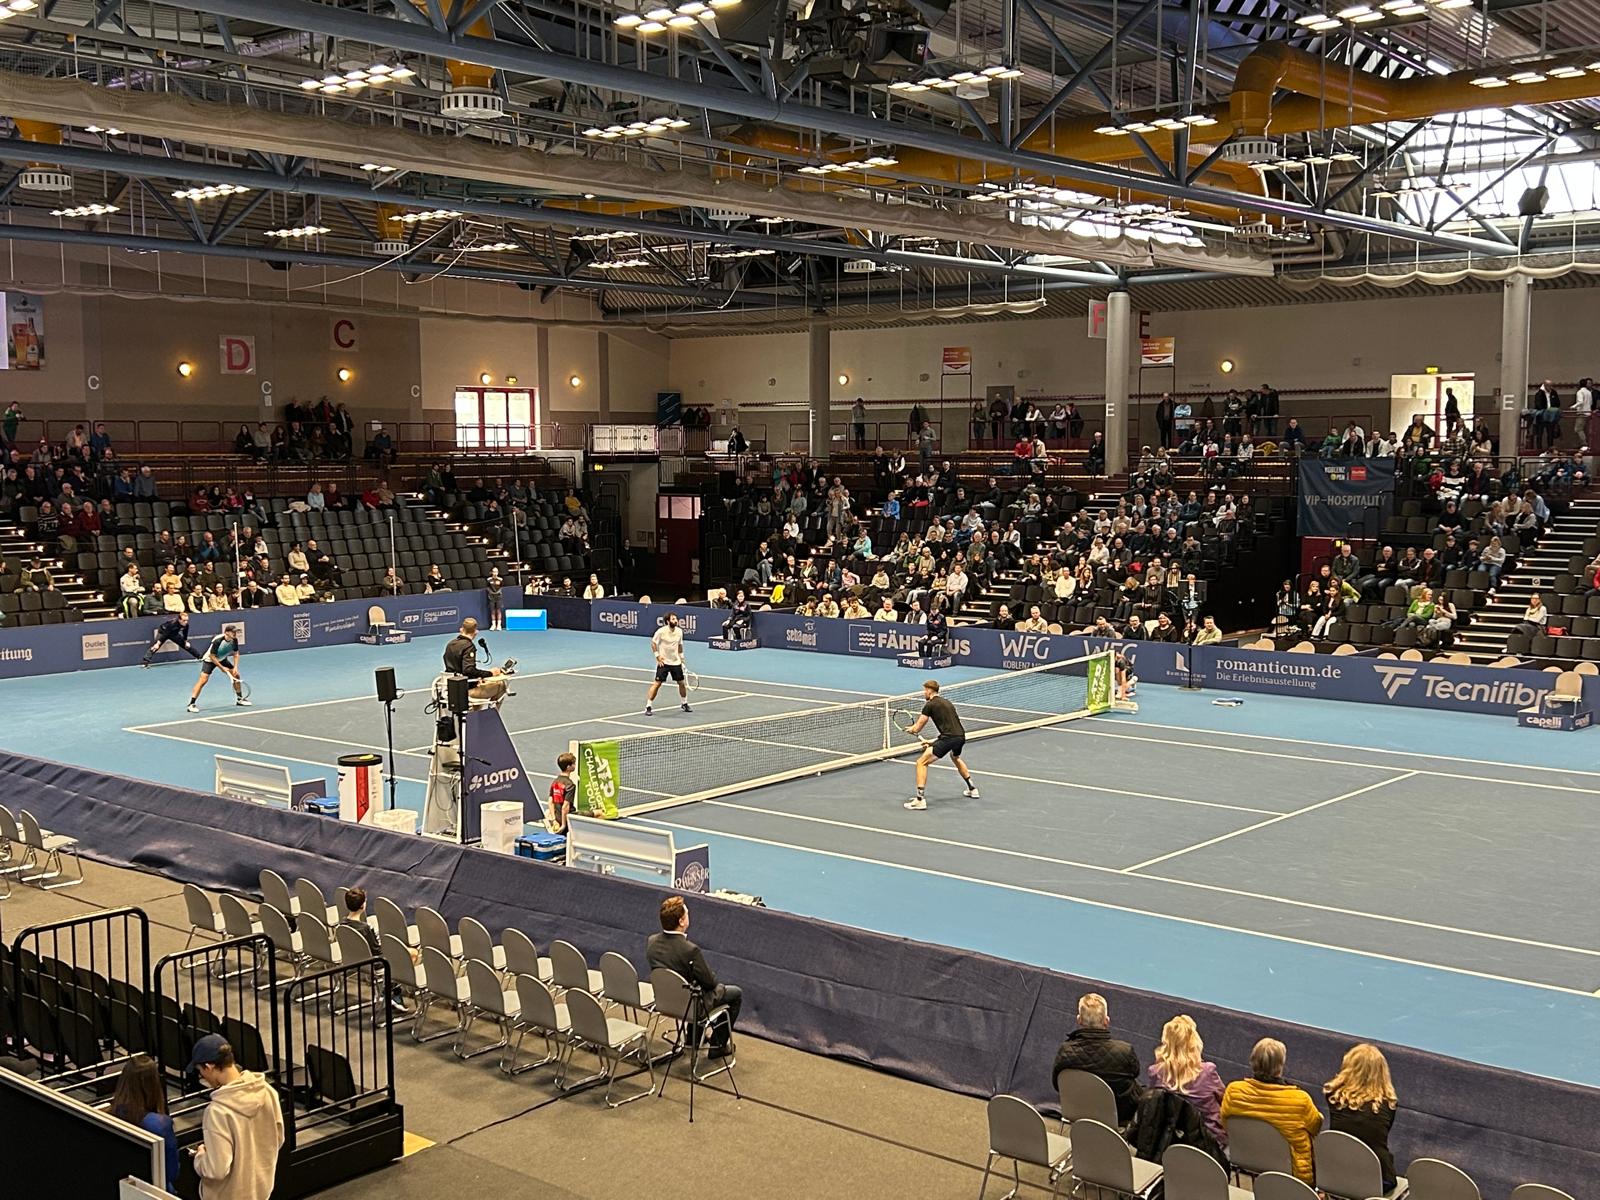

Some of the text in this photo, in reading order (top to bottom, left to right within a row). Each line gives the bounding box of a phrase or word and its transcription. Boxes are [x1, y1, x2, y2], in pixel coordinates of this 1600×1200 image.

[1092, 303, 1105, 336] F
[1139, 310, 1151, 339] E
[333, 319, 356, 349] C
[225, 338, 251, 371] D
[87, 375, 99, 390] C
[261, 381, 272, 395] C
[411, 385, 420, 398] C
[1105, 402, 1115, 416] E
[1503, 394, 1515, 410] E
[424, 609, 458, 618] CHALLENGER
[599, 610, 638, 627] capelli
[656, 614, 697, 630] celli
[85, 640, 106, 648] Outlet
[877, 629, 971, 656] FÄHRUS
[1000, 633, 1051, 660] WFG
[0, 647, 33, 661] itung
[1216, 658, 1342, 679] romanticum.de
[1216, 671, 1231, 682] Die
[1232, 673, 1317, 689] Erlebnisaustellung
[1526, 715, 1562, 727] capelli
[484, 767, 520, 787] LOTTO
[594, 753, 616, 798] ATP
[585, 781, 598, 812] TOUR
